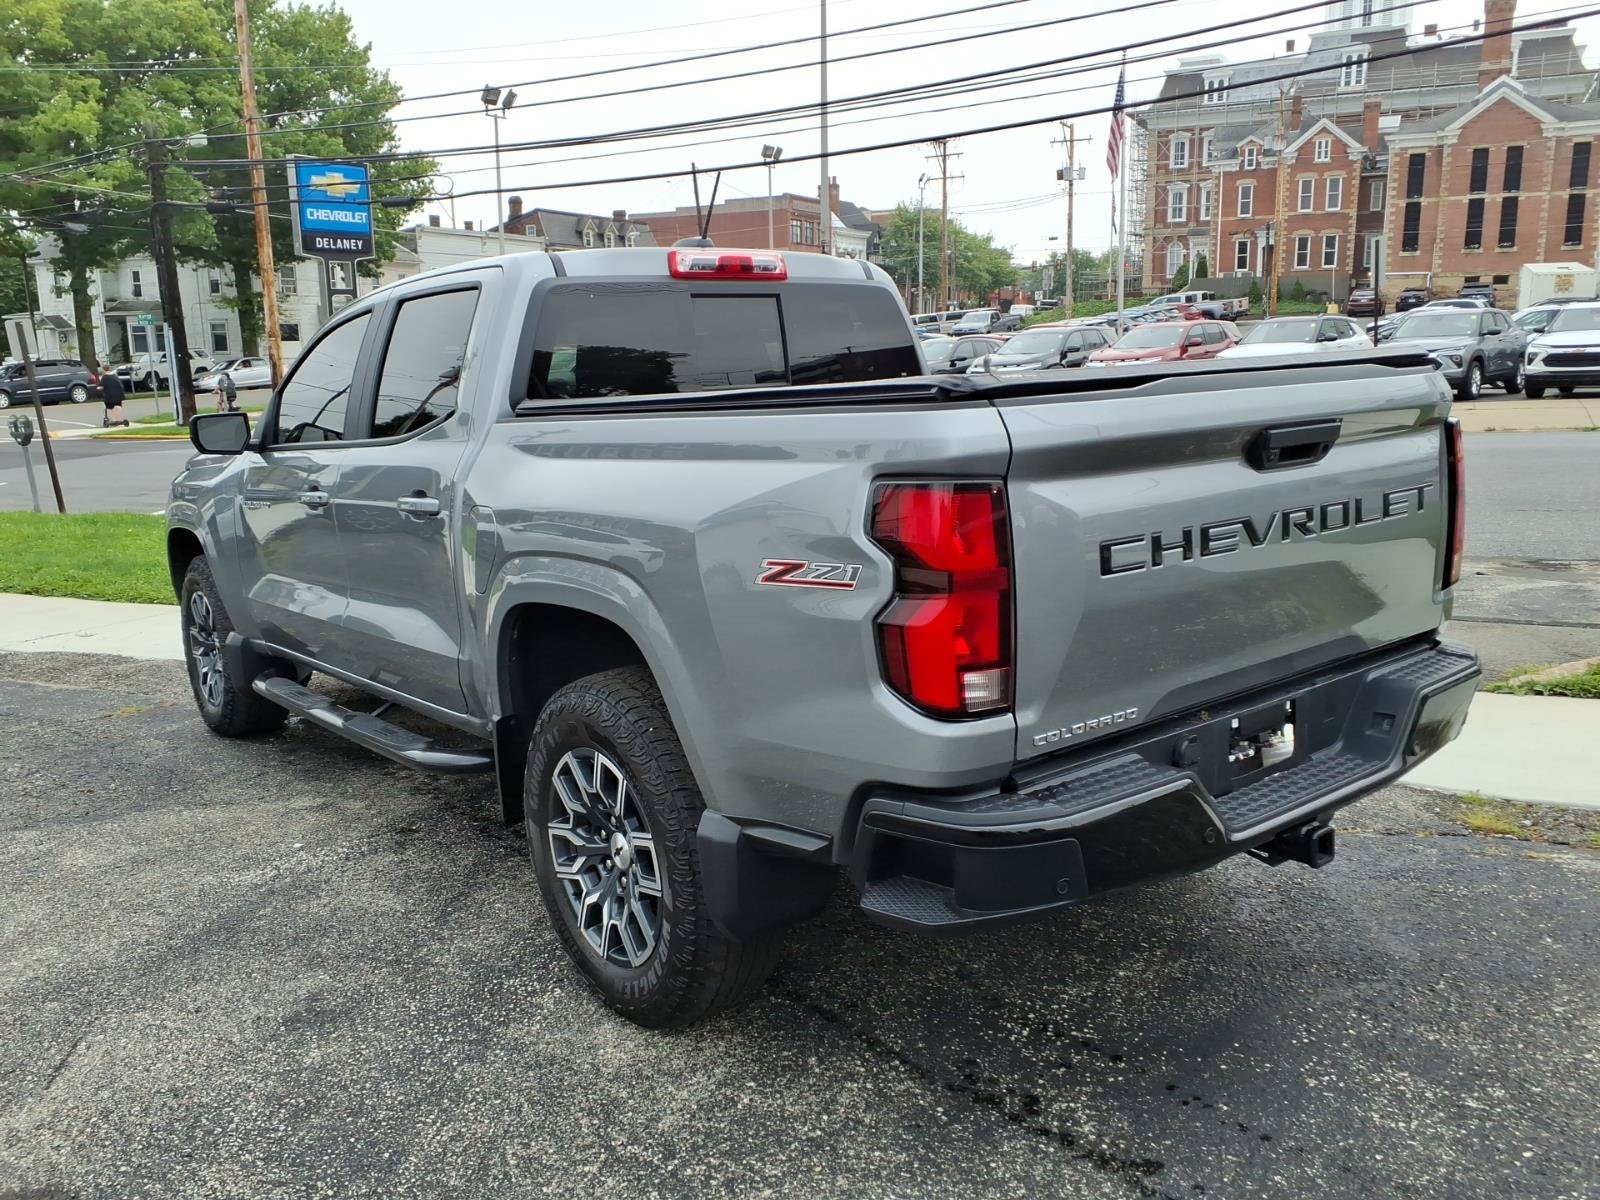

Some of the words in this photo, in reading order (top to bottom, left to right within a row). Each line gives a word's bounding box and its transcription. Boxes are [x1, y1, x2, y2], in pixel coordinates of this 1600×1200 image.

[306, 208, 368, 223] CHEVROLET
[316, 237, 363, 250] DELANEY
[1099, 481, 1434, 579] CHEVROLET
[754, 558, 863, 591] Z71
[1032, 707, 1139, 746] COLORADO
